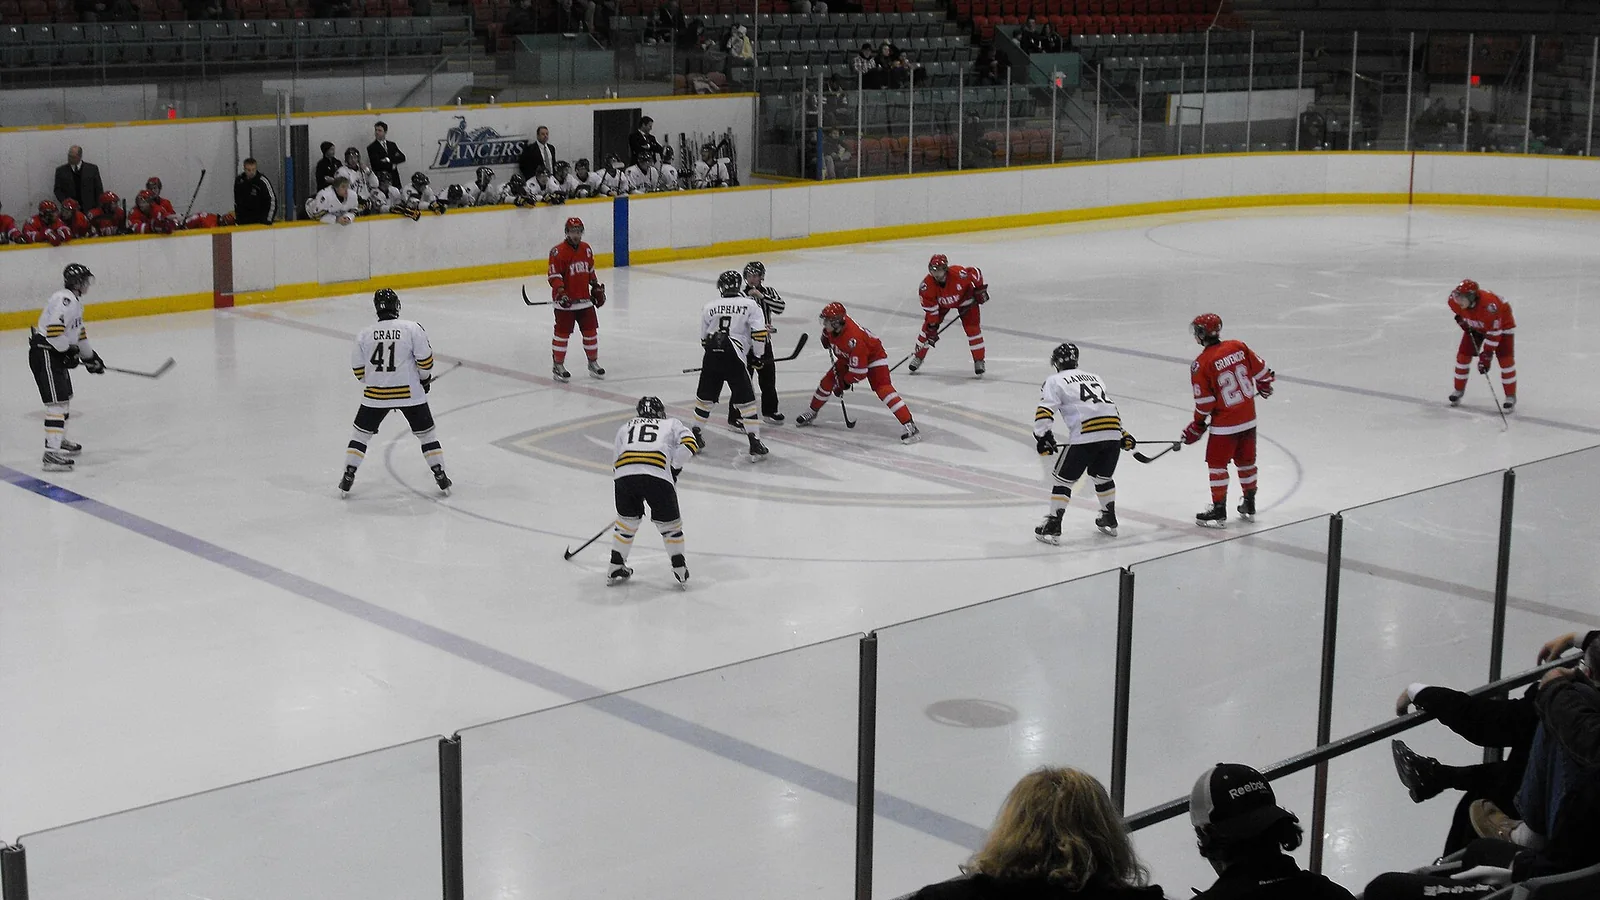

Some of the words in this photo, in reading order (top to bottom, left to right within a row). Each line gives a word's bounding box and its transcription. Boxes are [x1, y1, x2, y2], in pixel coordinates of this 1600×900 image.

[429, 139, 525, 169] LANCERS
[709, 305, 748, 317] OLIPHANT
[373, 329, 401, 341] CRAIG
[719, 316, 732, 335] 8
[370, 341, 396, 372] 41
[1080, 382, 1114, 404] 42
[1217, 363, 1255, 408] 26
[628, 424, 659, 444] 16
[1228, 780, 1268, 800] Reebok
